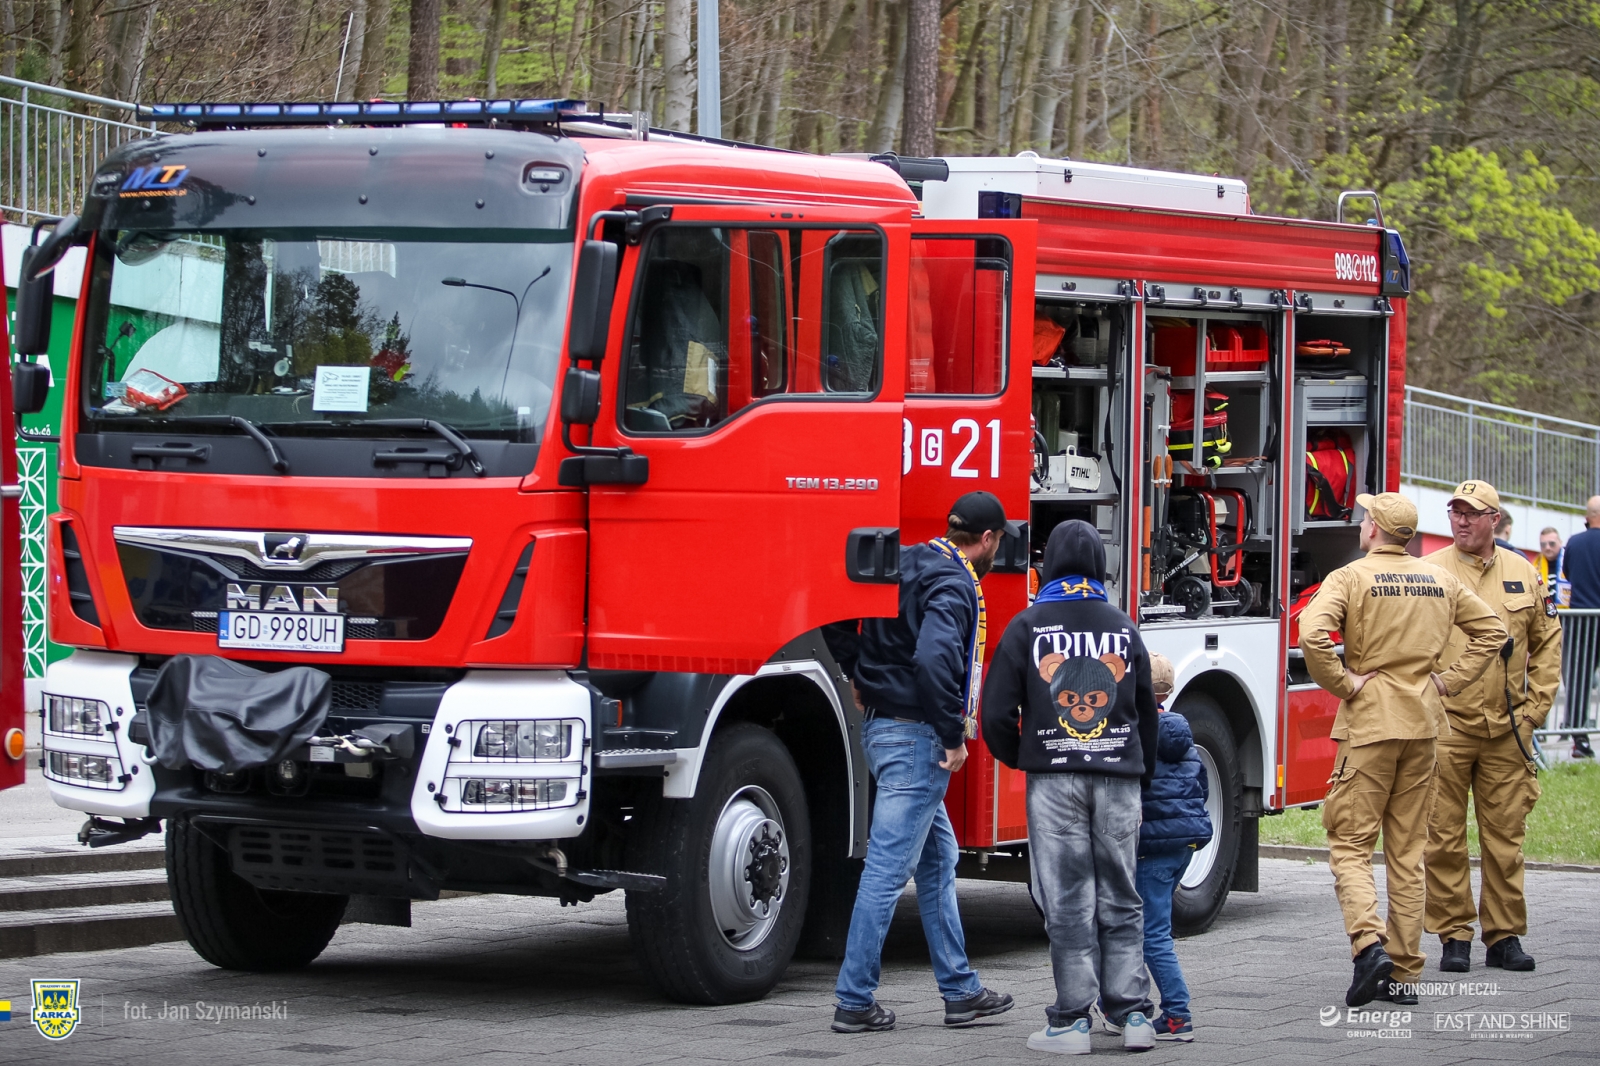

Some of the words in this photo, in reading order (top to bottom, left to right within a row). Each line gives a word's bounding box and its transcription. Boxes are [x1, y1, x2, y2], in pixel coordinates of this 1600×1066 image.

[1335, 252, 1353, 280] 998
[1362, 254, 1378, 282] 112
[925, 432, 939, 462] G
[951, 418, 1001, 478] 21
[785, 477, 820, 489] TGM
[822, 478, 879, 490] 13.290
[1071, 466, 1090, 479] STIHL
[1374, 572, 1437, 584] PAŃSTWOWA
[228, 584, 339, 613] MAN
[234, 615, 261, 640] GD
[270, 616, 337, 643] 998UH
[1033, 624, 1064, 634] PARTNER
[1033, 632, 1131, 673] CRIME
